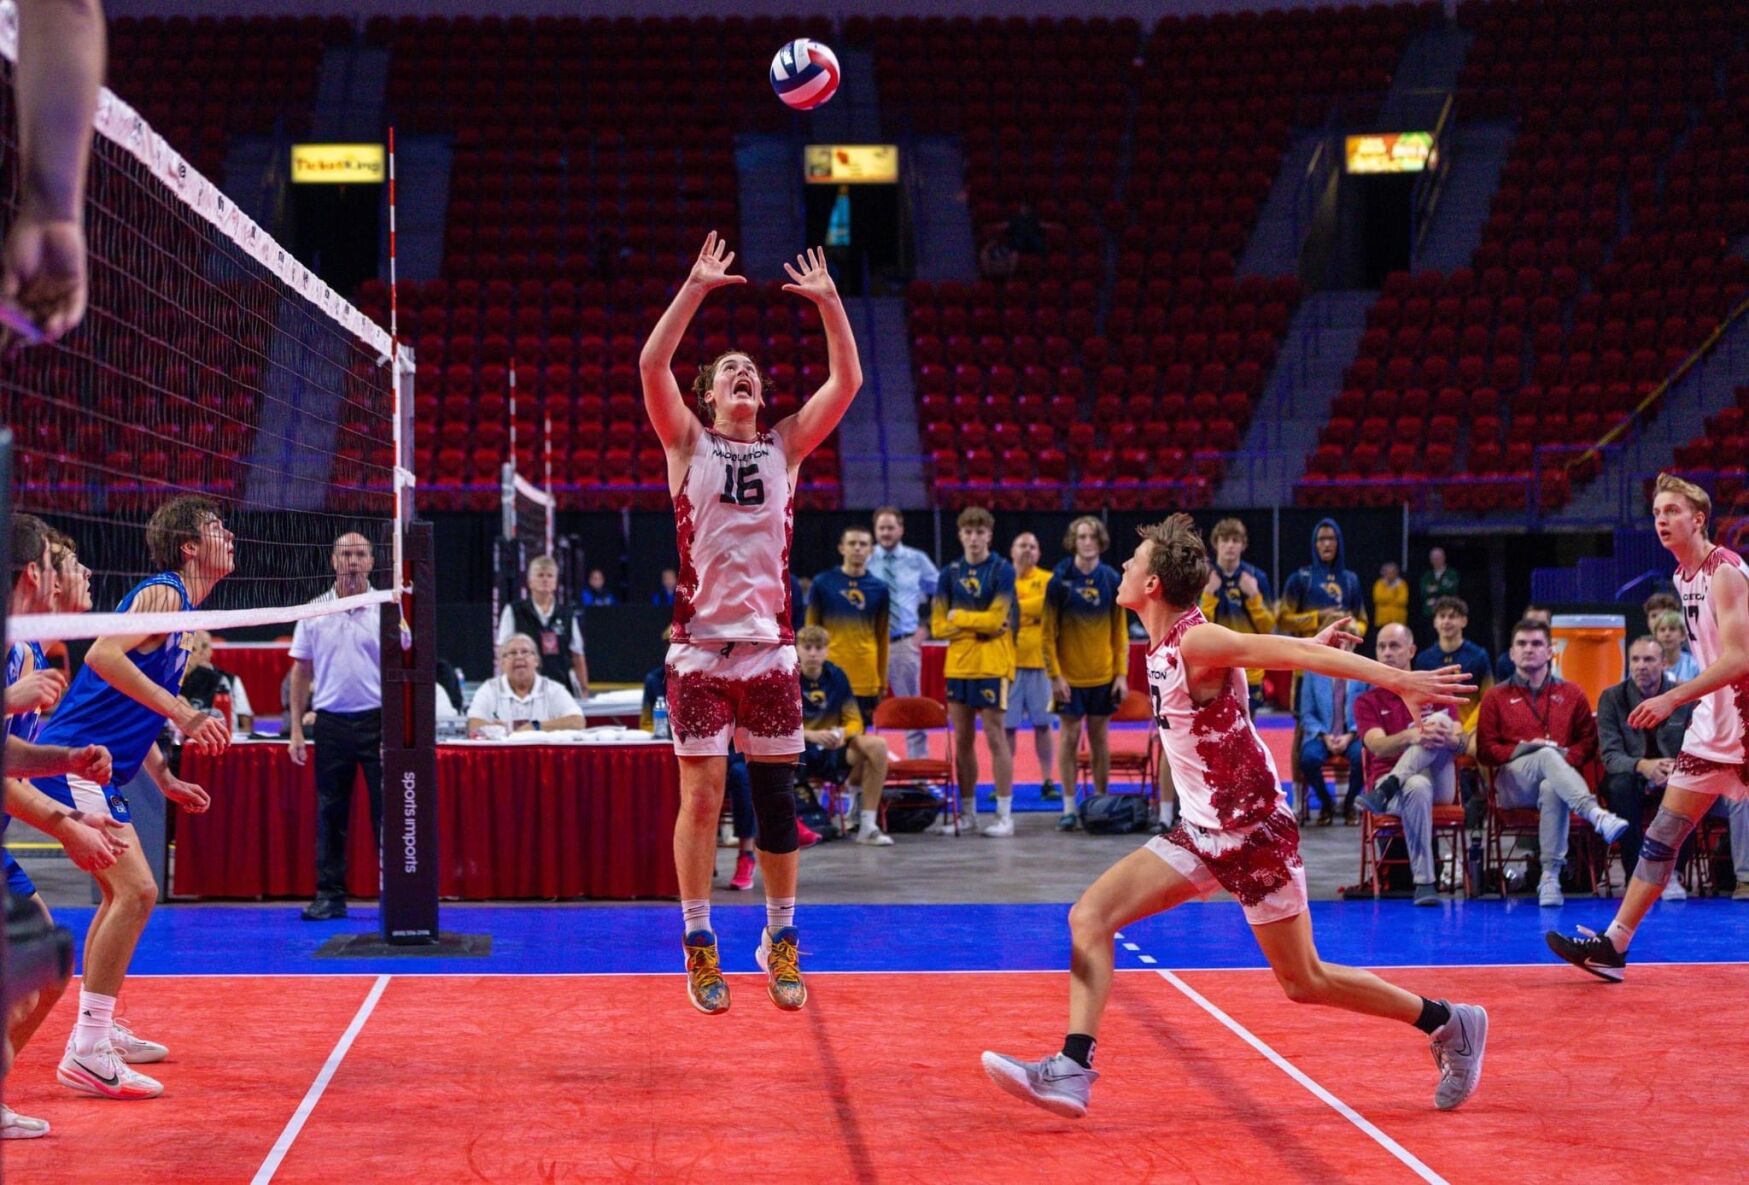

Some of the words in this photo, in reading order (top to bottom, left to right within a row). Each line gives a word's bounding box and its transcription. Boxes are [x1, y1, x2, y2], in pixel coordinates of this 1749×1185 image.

[719, 463, 765, 506] 16
[401, 771, 417, 817] sports
[402, 818, 418, 874] imports
